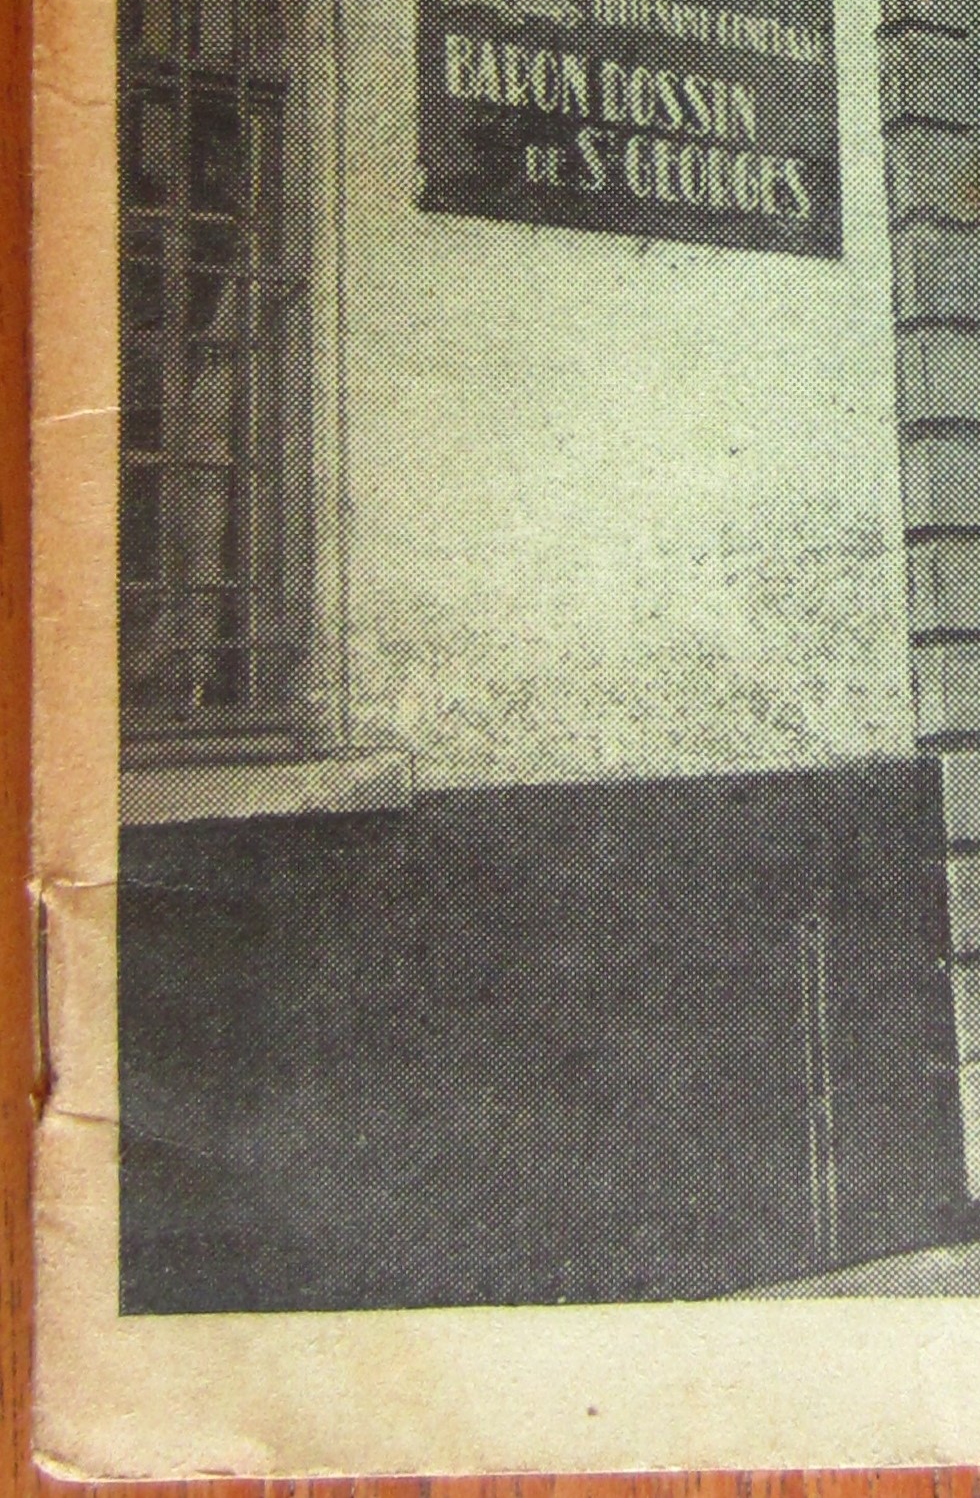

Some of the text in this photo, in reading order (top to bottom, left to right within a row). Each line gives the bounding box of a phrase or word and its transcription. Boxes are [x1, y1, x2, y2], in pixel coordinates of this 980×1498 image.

[445, 34, 756, 142] BARON DOSSIN
[625, 133, 811, 219] GEORGES
